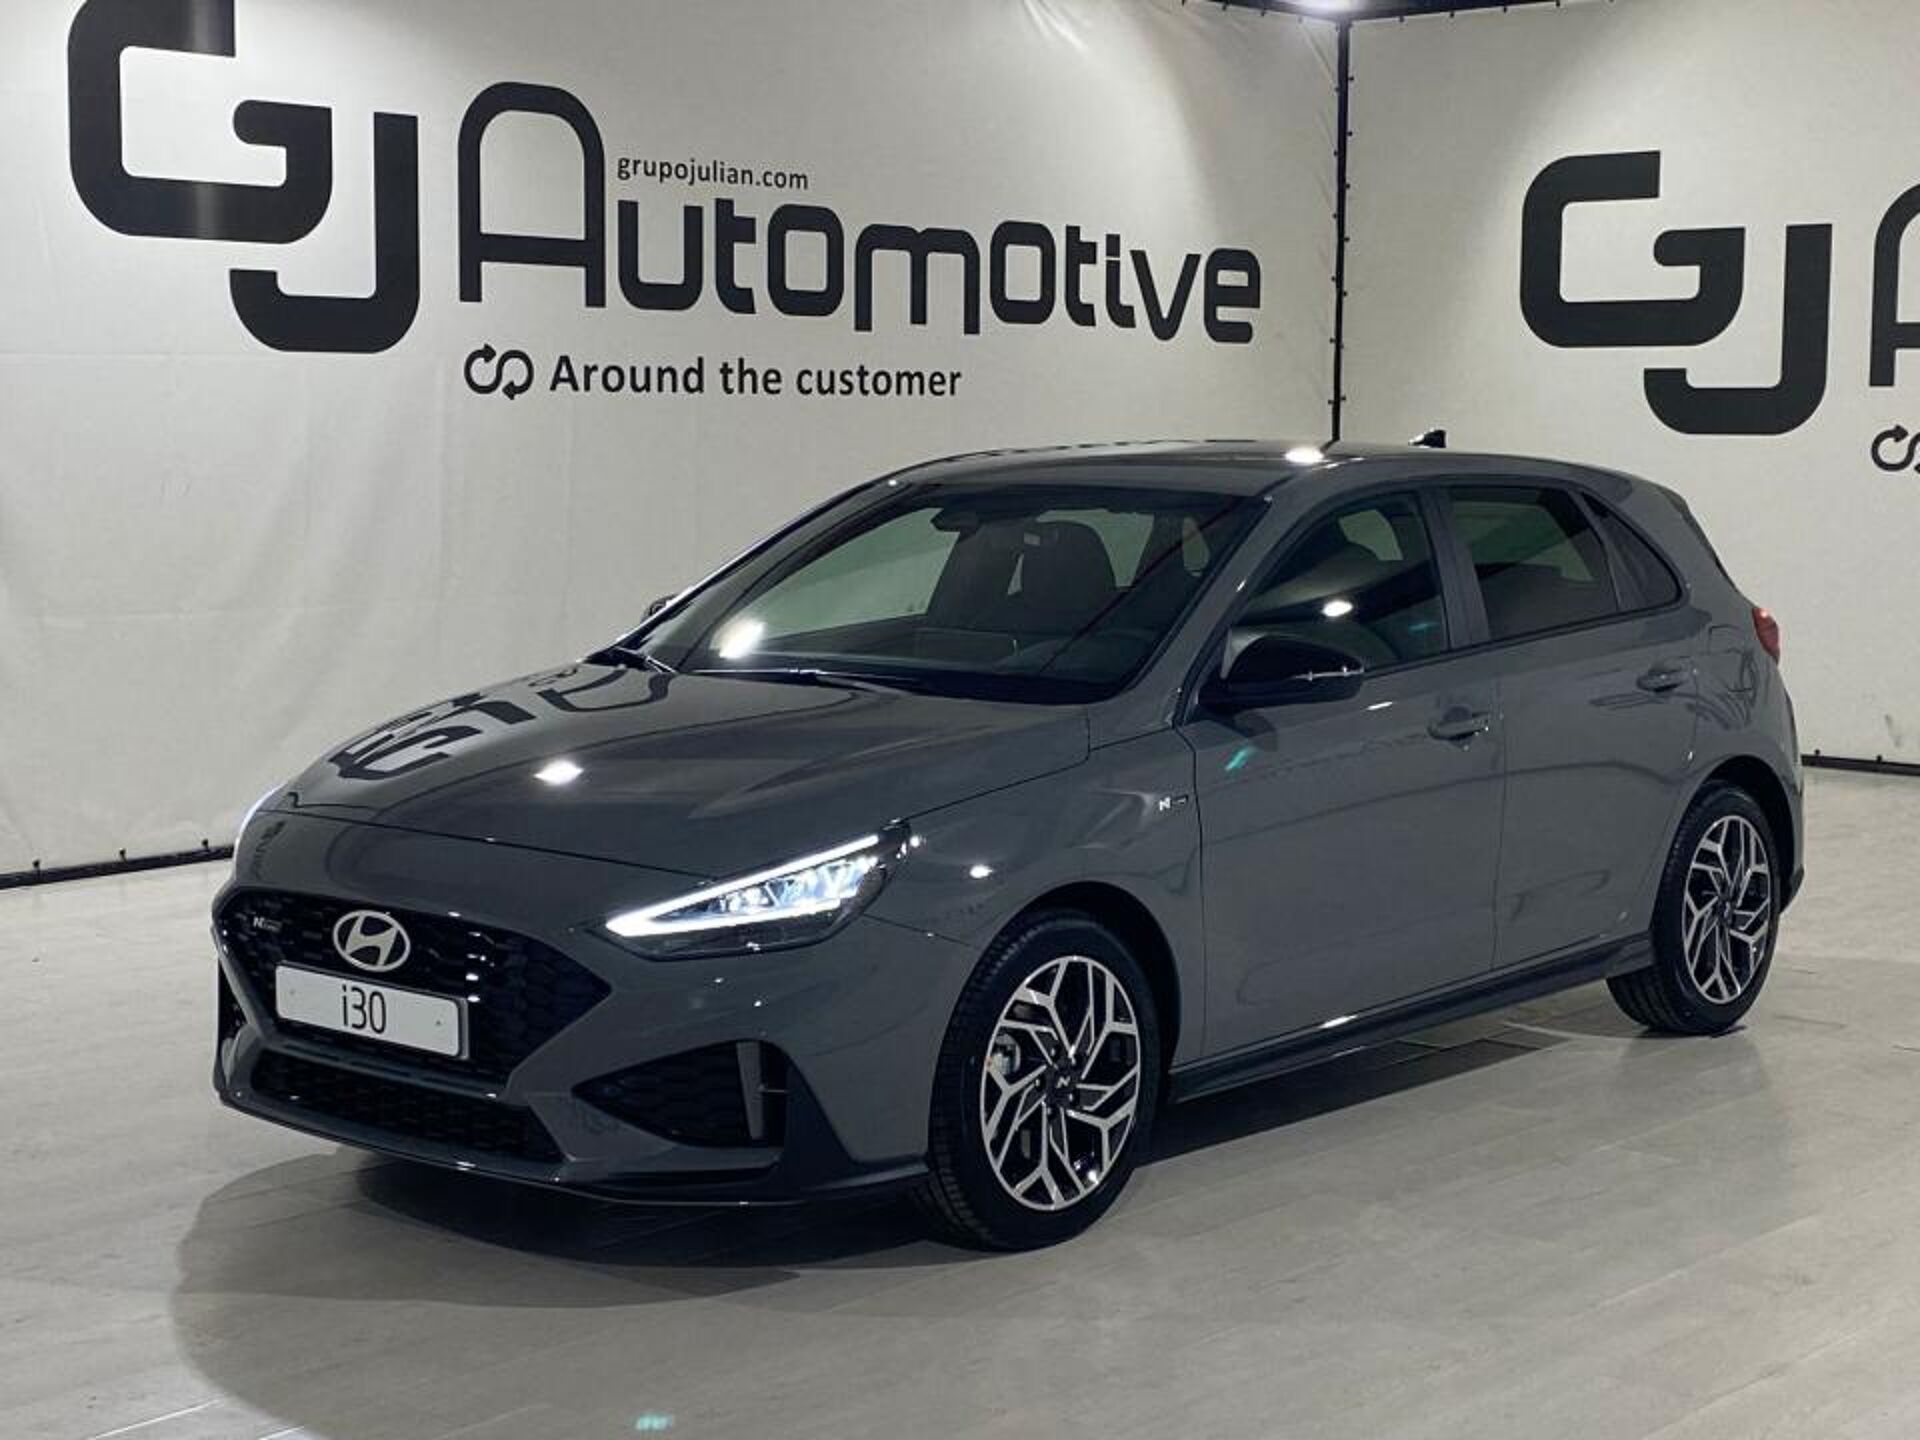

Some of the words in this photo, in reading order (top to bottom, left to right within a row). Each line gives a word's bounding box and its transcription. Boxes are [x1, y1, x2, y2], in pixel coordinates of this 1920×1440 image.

[617, 157, 809, 190] grupojulian.com
[1520, 150, 1832, 436] GJ
[549, 354, 705, 395] Around
[719, 356, 783, 396] the
[795, 364, 962, 397] customer
[341, 984, 387, 1035] i30
